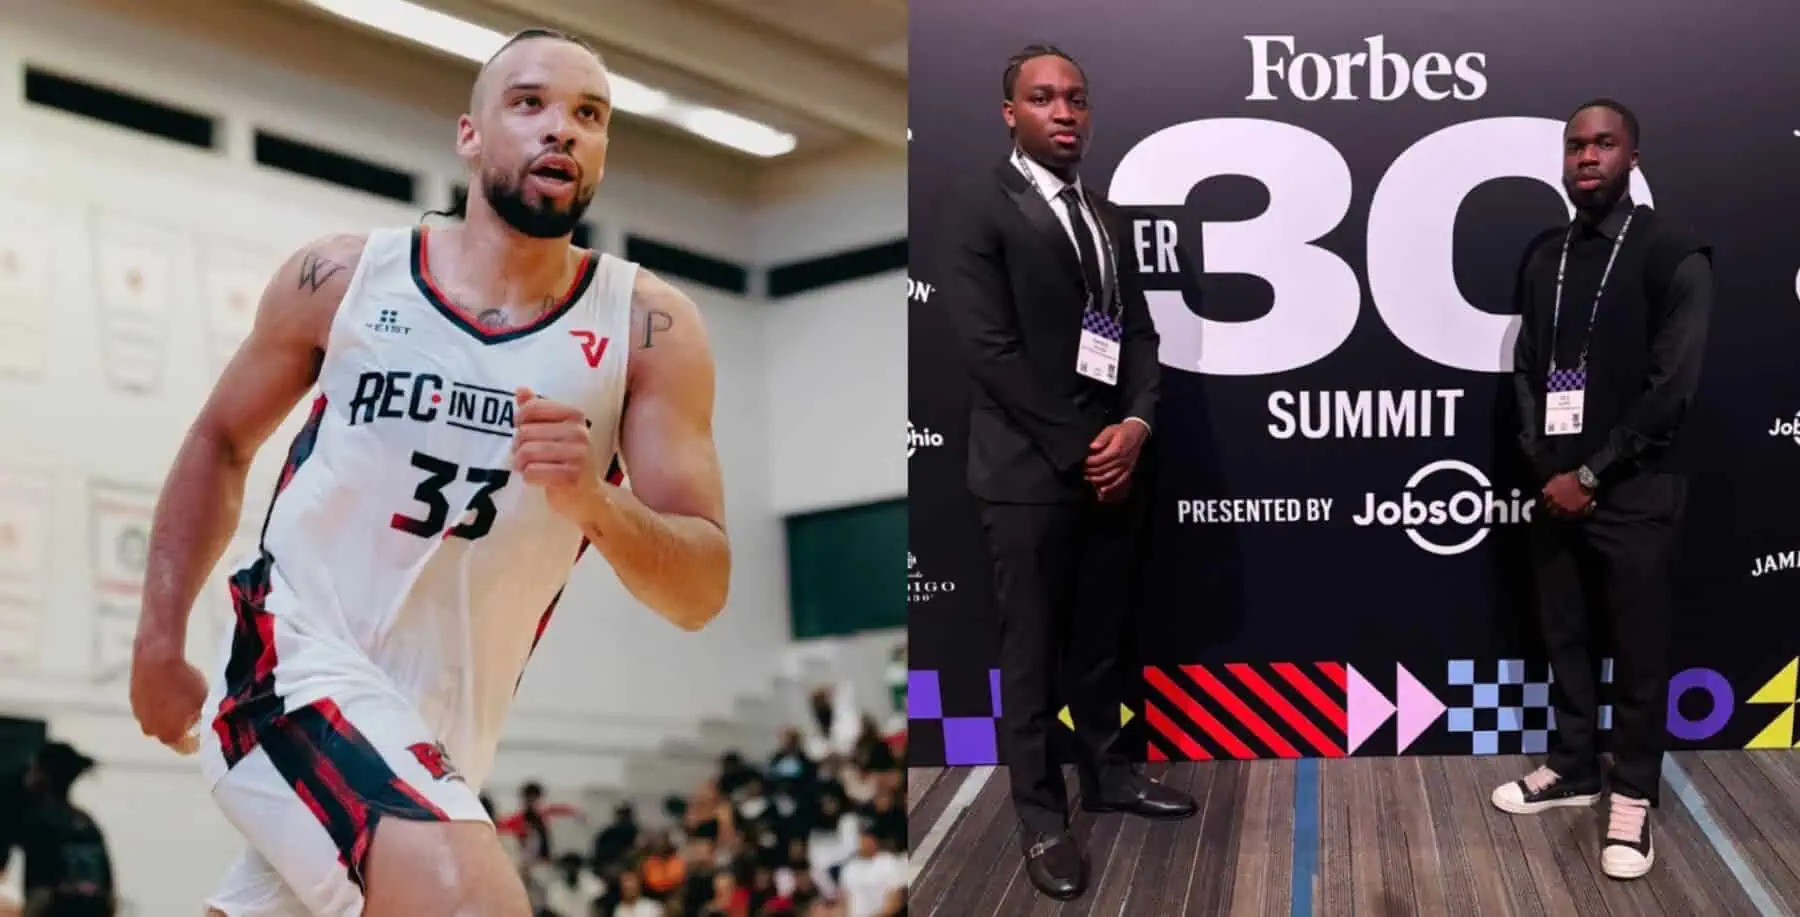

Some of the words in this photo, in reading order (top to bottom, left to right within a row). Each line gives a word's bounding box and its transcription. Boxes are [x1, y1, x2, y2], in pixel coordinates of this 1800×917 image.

[1243, 33, 1488, 102] Forbes
[1107, 115, 1655, 375] 30
[1133, 219, 1180, 273] ER
[348, 371, 443, 426] REC
[448, 389, 476, 420] IN
[481, 397, 515, 429] DA
[1266, 388, 1465, 440] SUMMIT
[907, 428, 944, 447] hio
[390, 450, 511, 541] 33
[1177, 498, 1301, 523] PRESENTED
[1306, 497, 1334, 522] BY
